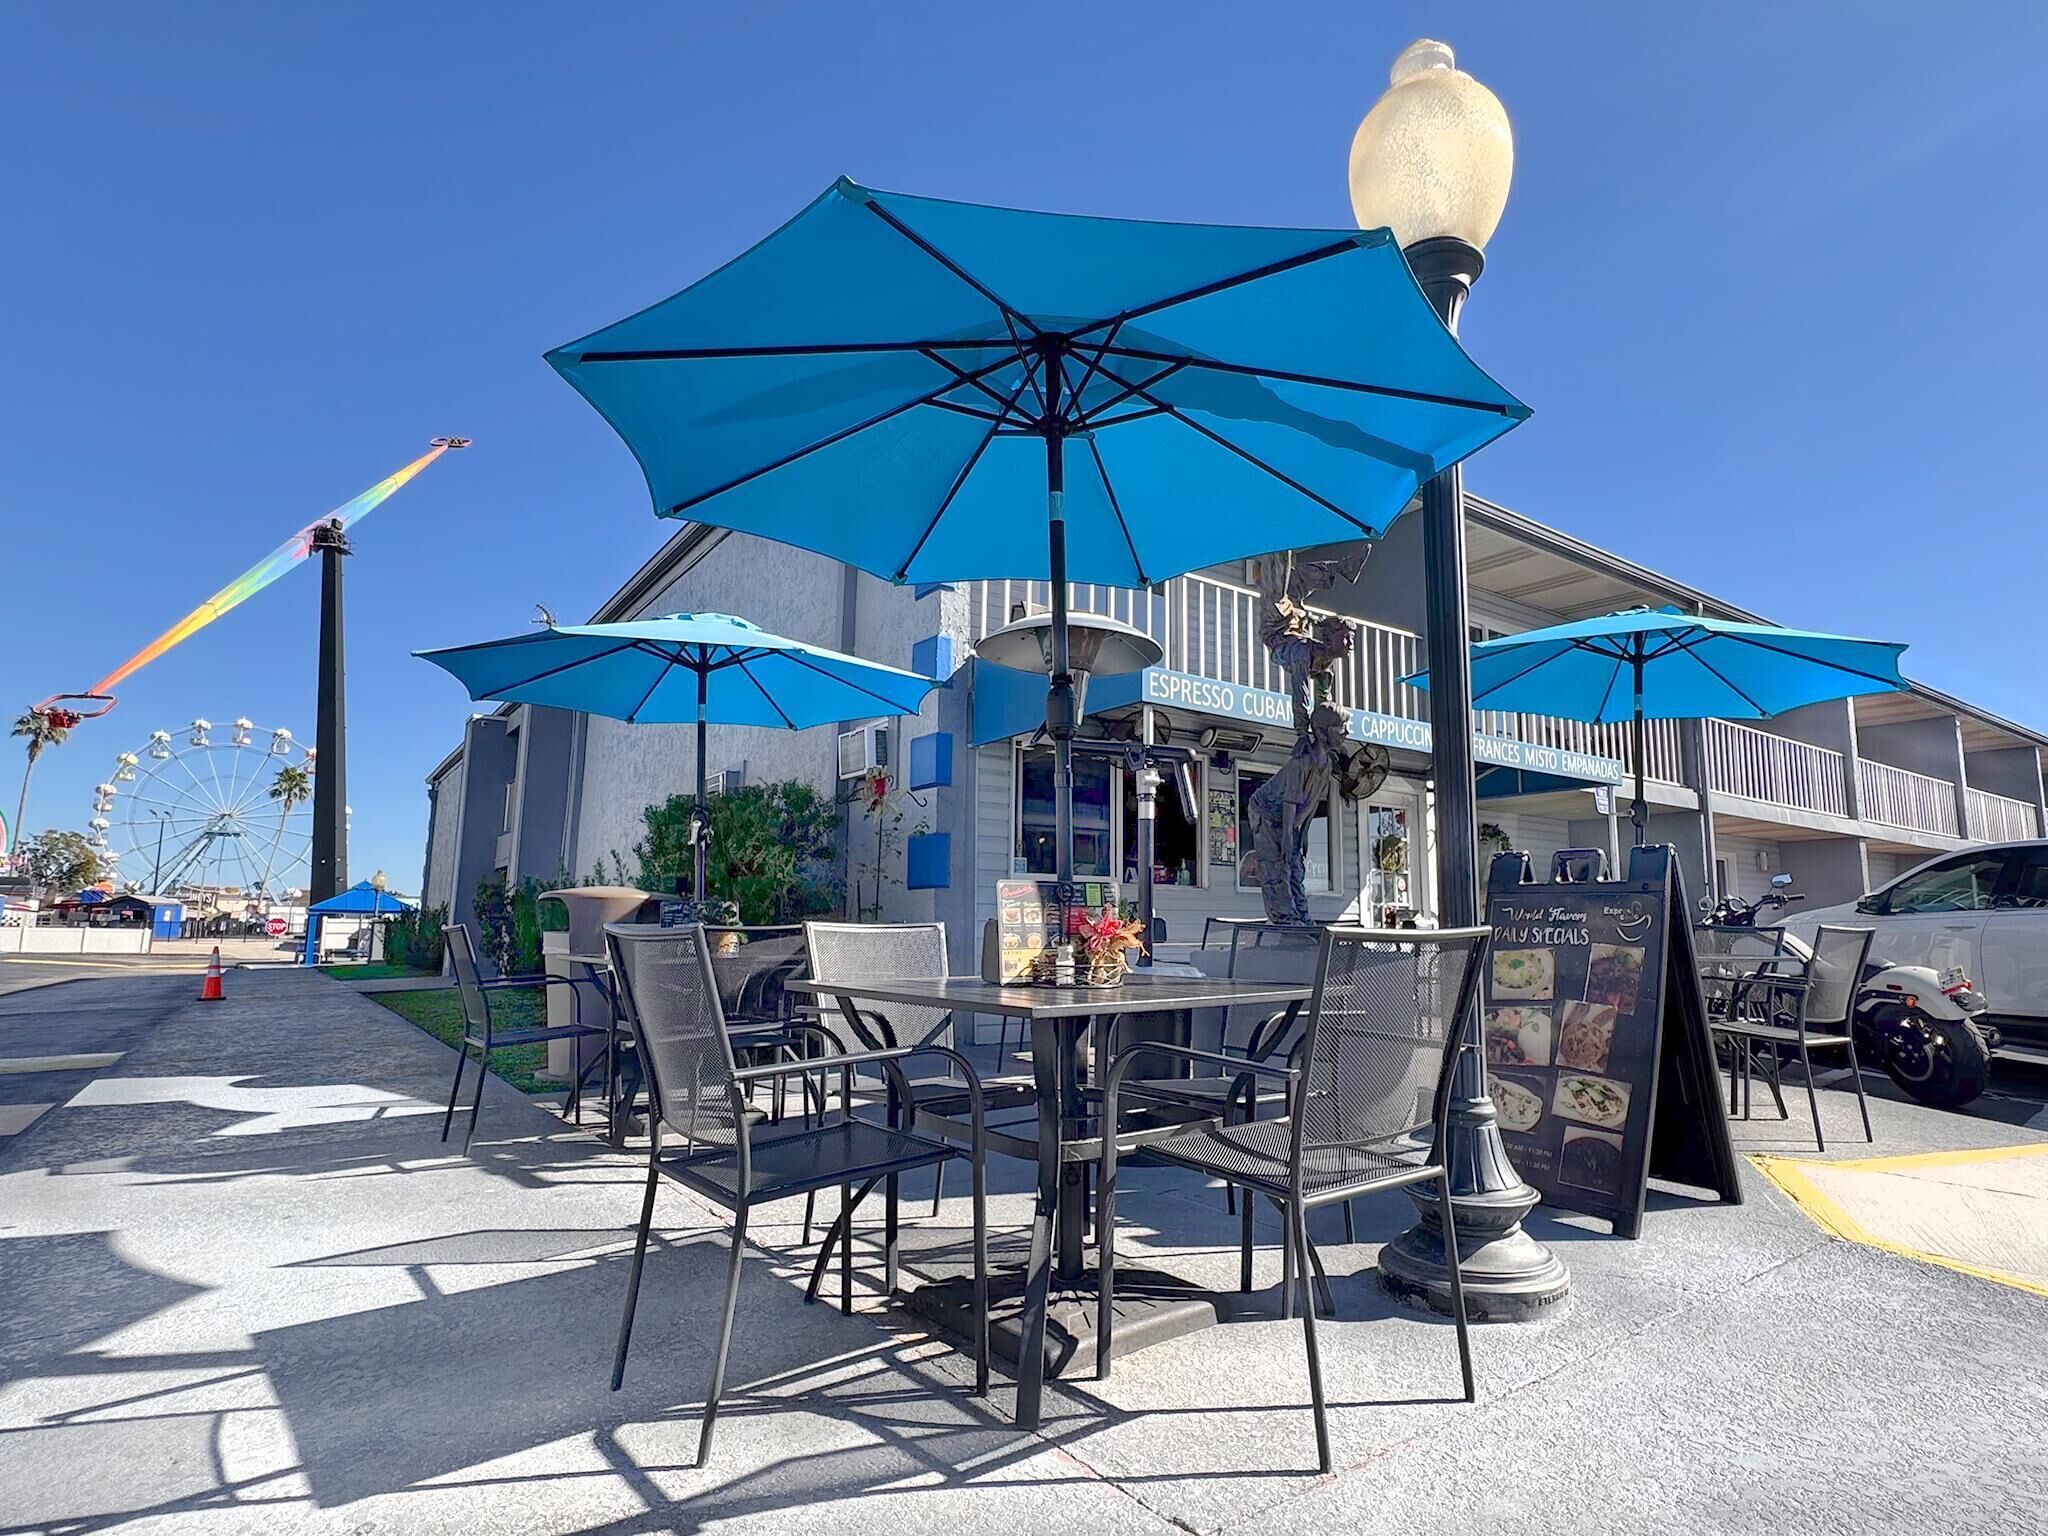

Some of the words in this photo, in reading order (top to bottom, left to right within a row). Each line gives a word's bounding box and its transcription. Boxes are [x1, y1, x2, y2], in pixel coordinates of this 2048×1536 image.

[1149, 671, 1234, 711] ESPRESSO
[1361, 716, 1432, 747] CAPPUCCIN
[1473, 737, 1520, 764] FRANCES
[1525, 747, 1557, 770] MISTO
[1561, 754, 1619, 780] EMPANADAS
[1502, 907, 1543, 921] World
[1548, 906, 1588, 922] Flavors
[267, 923, 287, 932] STOP
[1494, 926, 1529, 944] DAILY
[1531, 926, 1590, 946] SPECIALS
